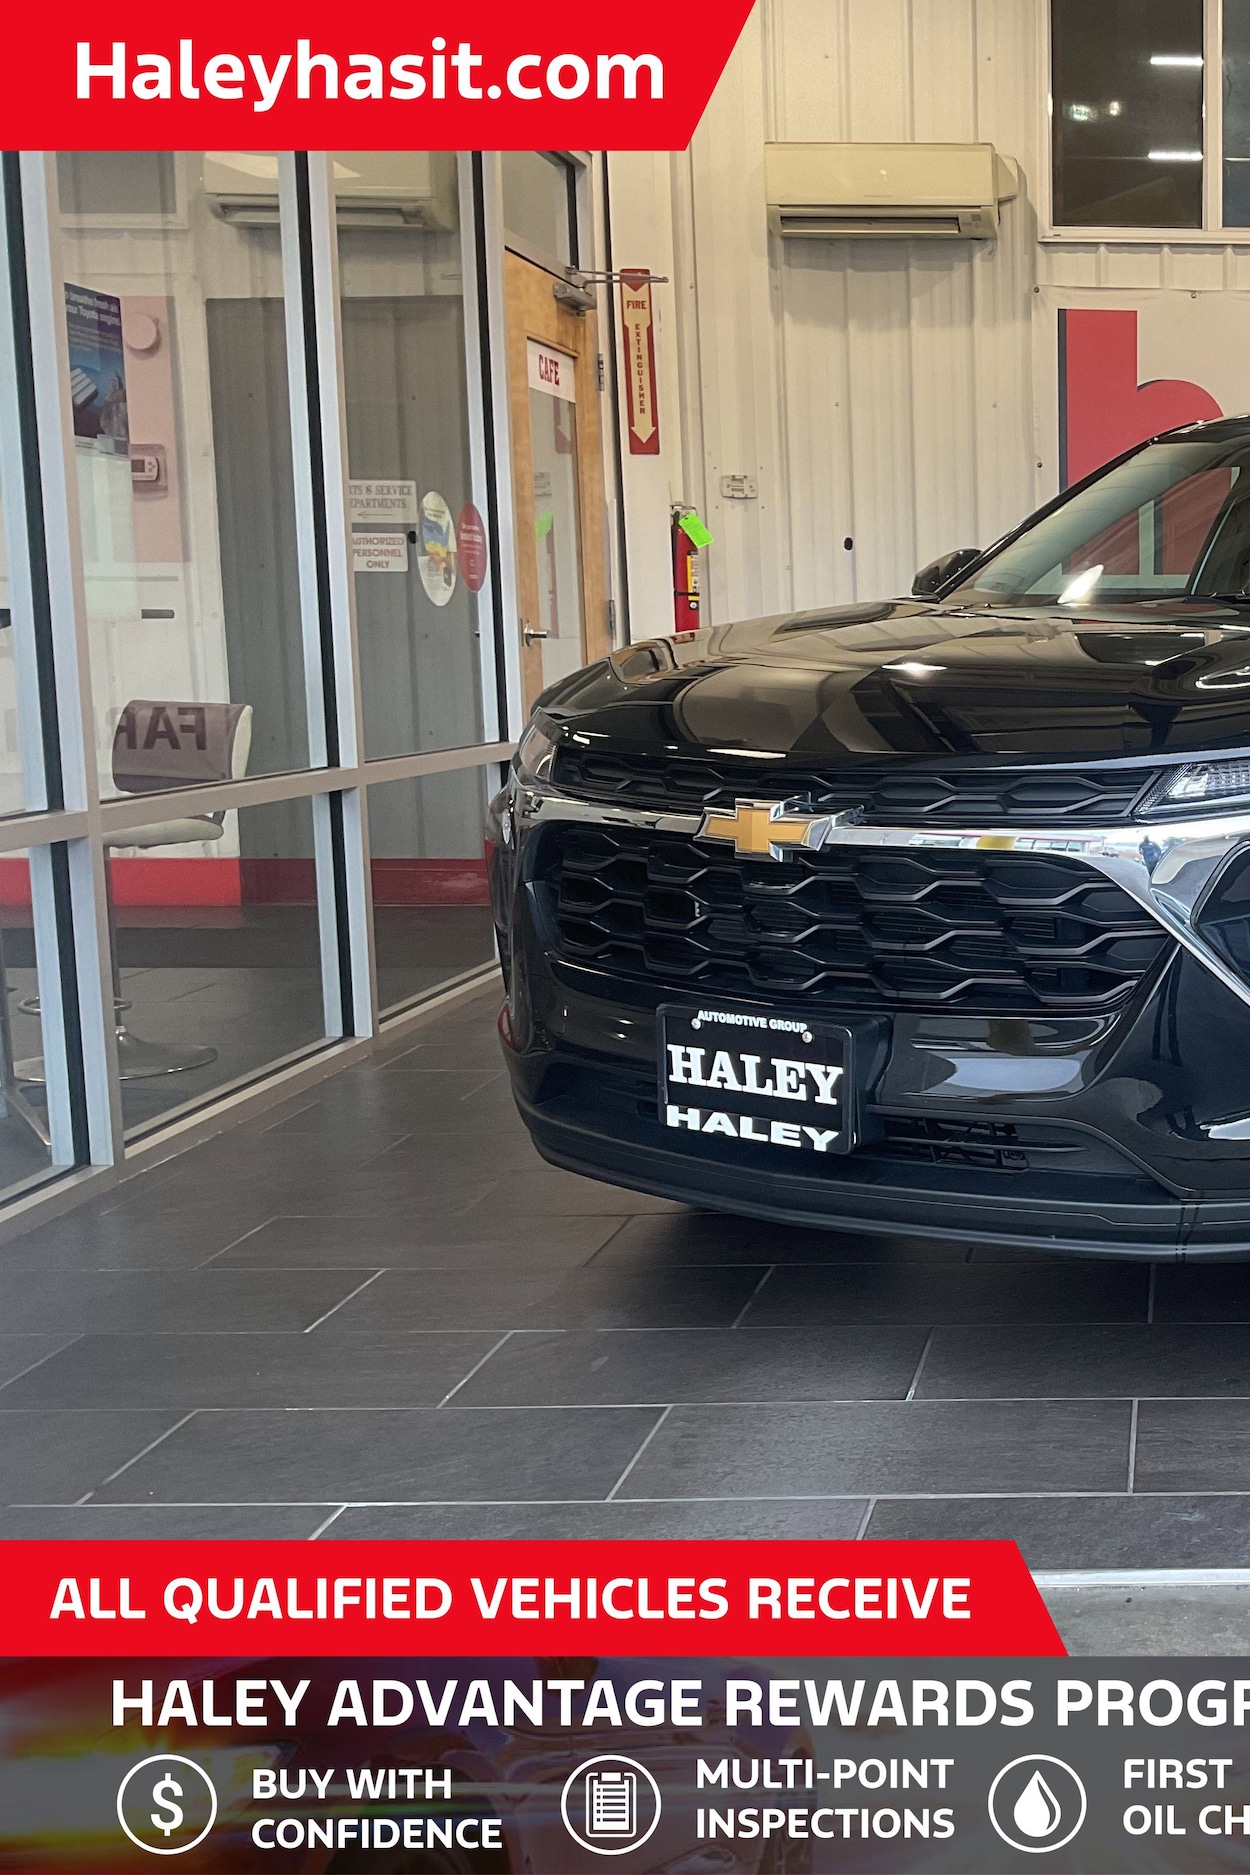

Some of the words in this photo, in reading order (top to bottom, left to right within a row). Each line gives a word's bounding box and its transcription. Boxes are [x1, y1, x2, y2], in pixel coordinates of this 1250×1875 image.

[626, 300, 647, 310] FIRE
[538, 354, 560, 386] CAFE
[634, 323, 646, 415] EXTINGUISHER
[365, 485, 372, 496] &
[375, 485, 413, 496] SERVICE
[352, 548, 403, 558] PERSONNEL
[366, 560, 390, 569] ONLY
[697, 1010, 768, 1029] AUTOMOTIVE
[769, 1019, 808, 1034] GROUP
[667, 1043, 844, 1106] HALEY
[666, 1105, 840, 1152] HALEY
